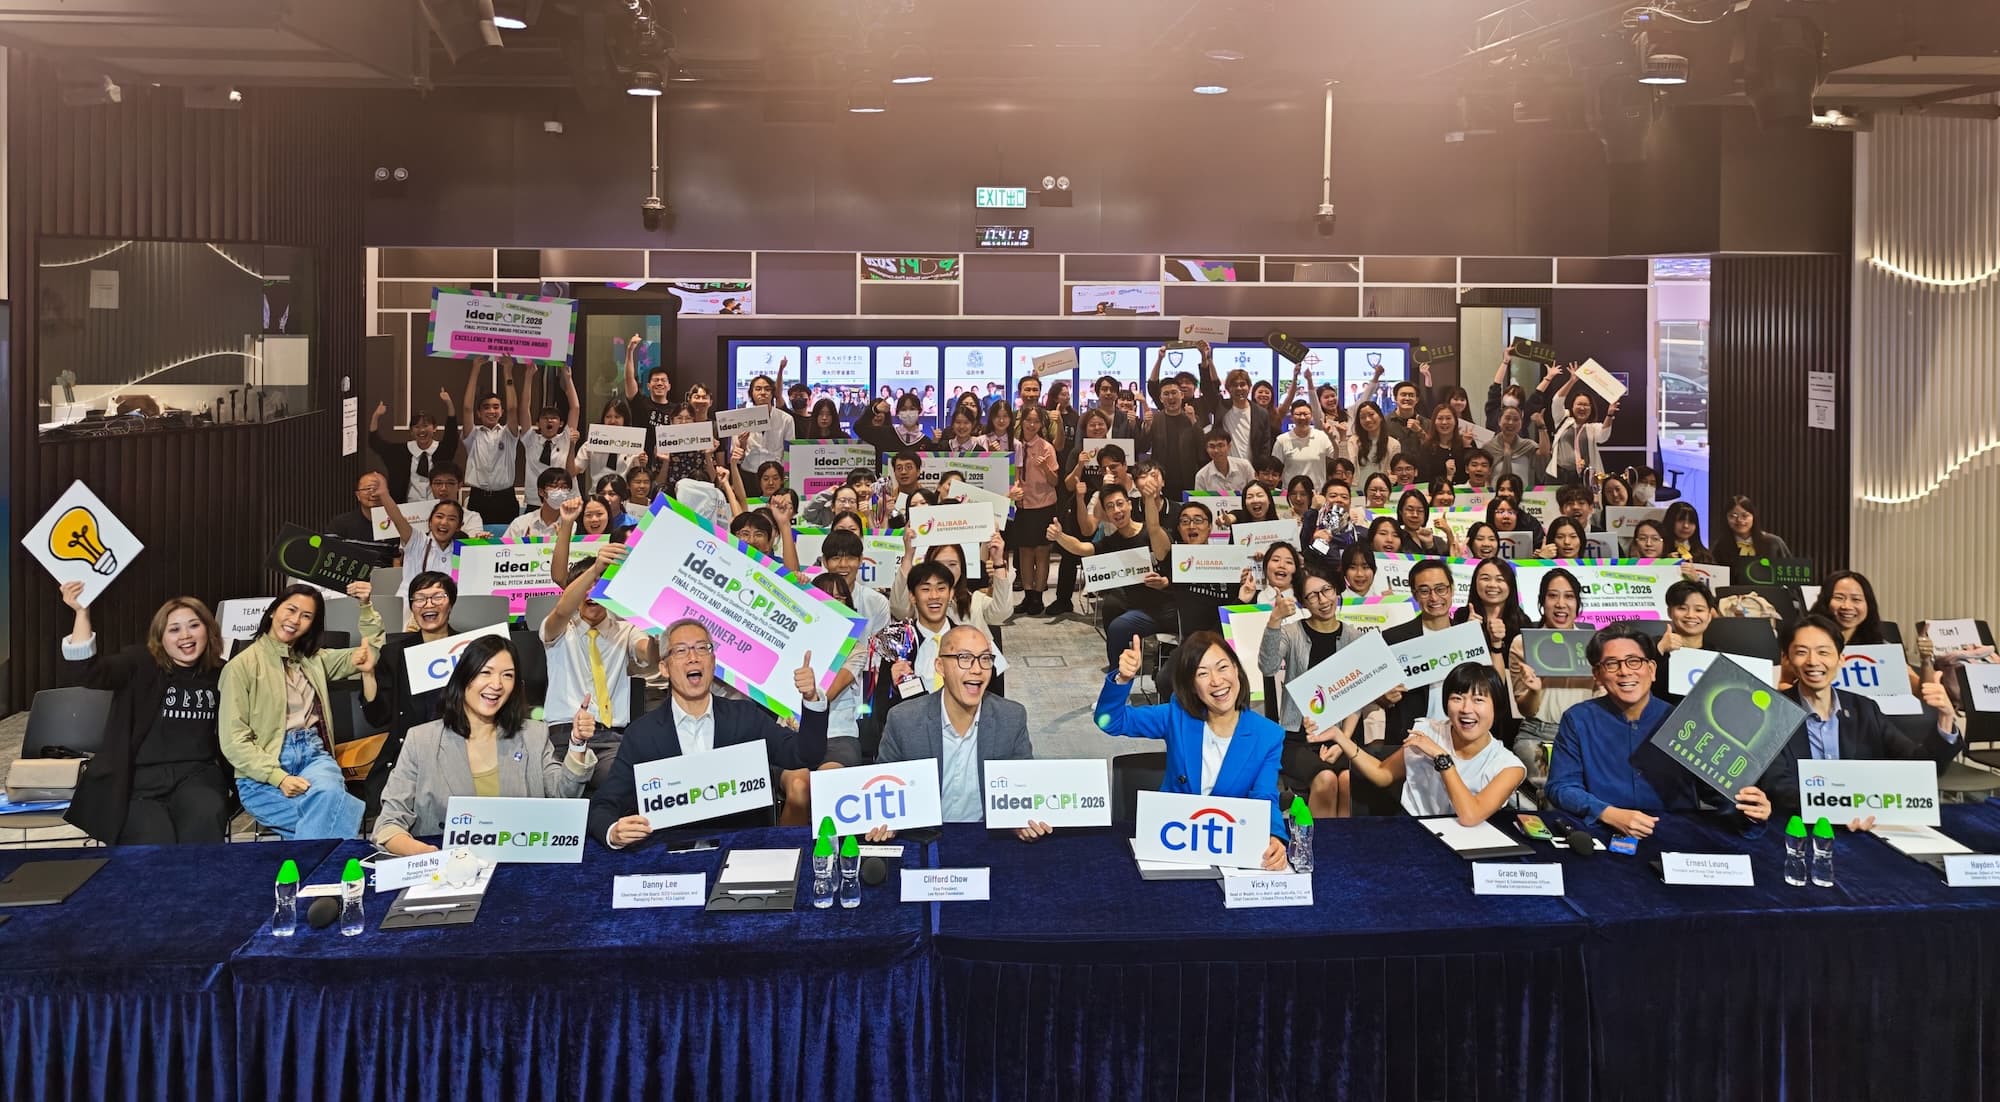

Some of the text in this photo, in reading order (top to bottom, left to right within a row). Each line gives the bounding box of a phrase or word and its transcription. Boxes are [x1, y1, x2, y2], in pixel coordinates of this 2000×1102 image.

[978, 189, 1005, 206] EXIT
[1006, 189, 1025, 206] 出口
[937, 519, 968, 527] ALIBABA
[495, 550, 511, 558] citi
[696, 540, 716, 555] citi
[324, 551, 370, 579] SEED
[1777, 565, 1811, 577] SEED
[1631, 585, 1652, 594] 2026
[243, 608, 261, 616] TEAM
[672, 575, 786, 650] FINAL PITCH AND AWARD PRESENTATION
[770, 609, 798, 633] 2026
[1465, 646, 1485, 659] 2026
[1328, 669, 1363, 695] ALIBABA
[1331, 663, 1388, 701] ENTREPRENEURS FUND
[1678, 720, 1747, 777] SEED
[1668, 739, 1733, 789] FOUNDATION
[641, 780, 661, 791] citi
[990, 779, 1008, 788] citi
[1805, 777, 1825, 787] citi
[644, 777, 766, 813] IdeaPOP! 2026
[991, 793, 1105, 810] IdeaPOP! 2026
[1807, 792, 1934, 809] IdeaPOP! 2026
[834, 784, 906, 824] citi
[451, 815, 472, 824] citi
[449, 830, 579, 847] IdeaPOP! 2026
[1160, 817, 1234, 854] citi
[407, 857, 439, 869] Freda Ng
[1685, 859, 1729, 869] Ernest Leung
[1971, 861, 1995, 870] Hayden
[923, 874, 968, 884] Clifford Chow
[1498, 870, 1538, 879] Grace Wong
[642, 880, 678, 890] Danny Lee
[1251, 880, 1288, 889] Vicky Kong
